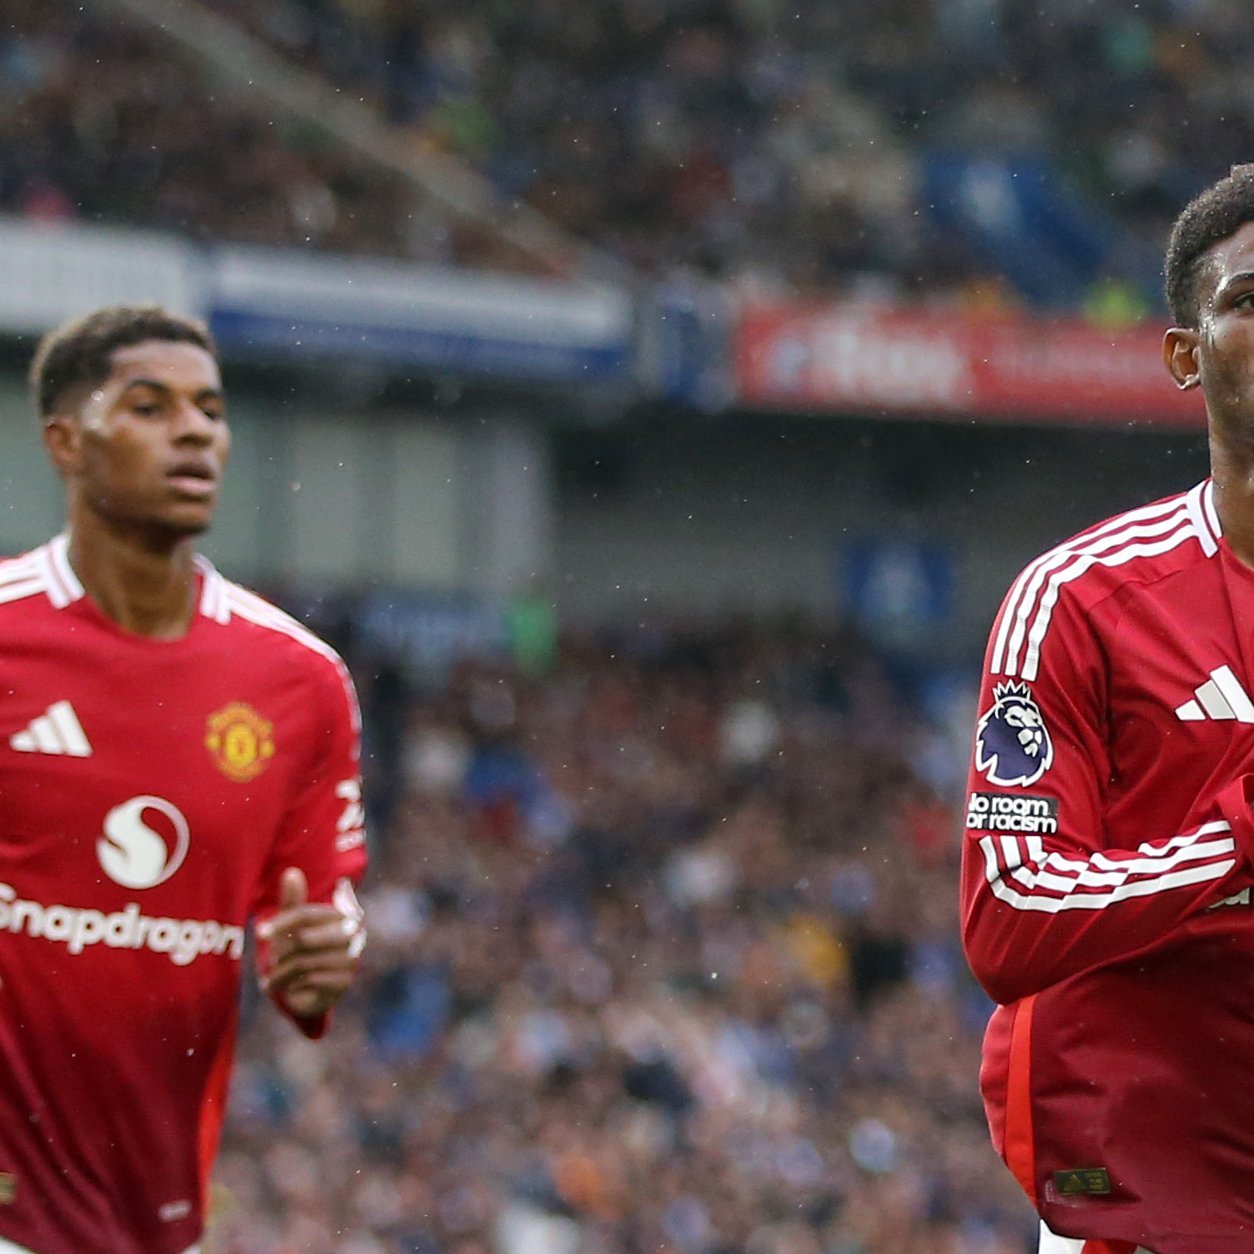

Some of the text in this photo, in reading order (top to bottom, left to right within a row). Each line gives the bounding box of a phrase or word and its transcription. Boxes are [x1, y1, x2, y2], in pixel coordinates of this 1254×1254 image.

[991, 797, 1049, 816] room
[966, 812, 1057, 833] or racism
